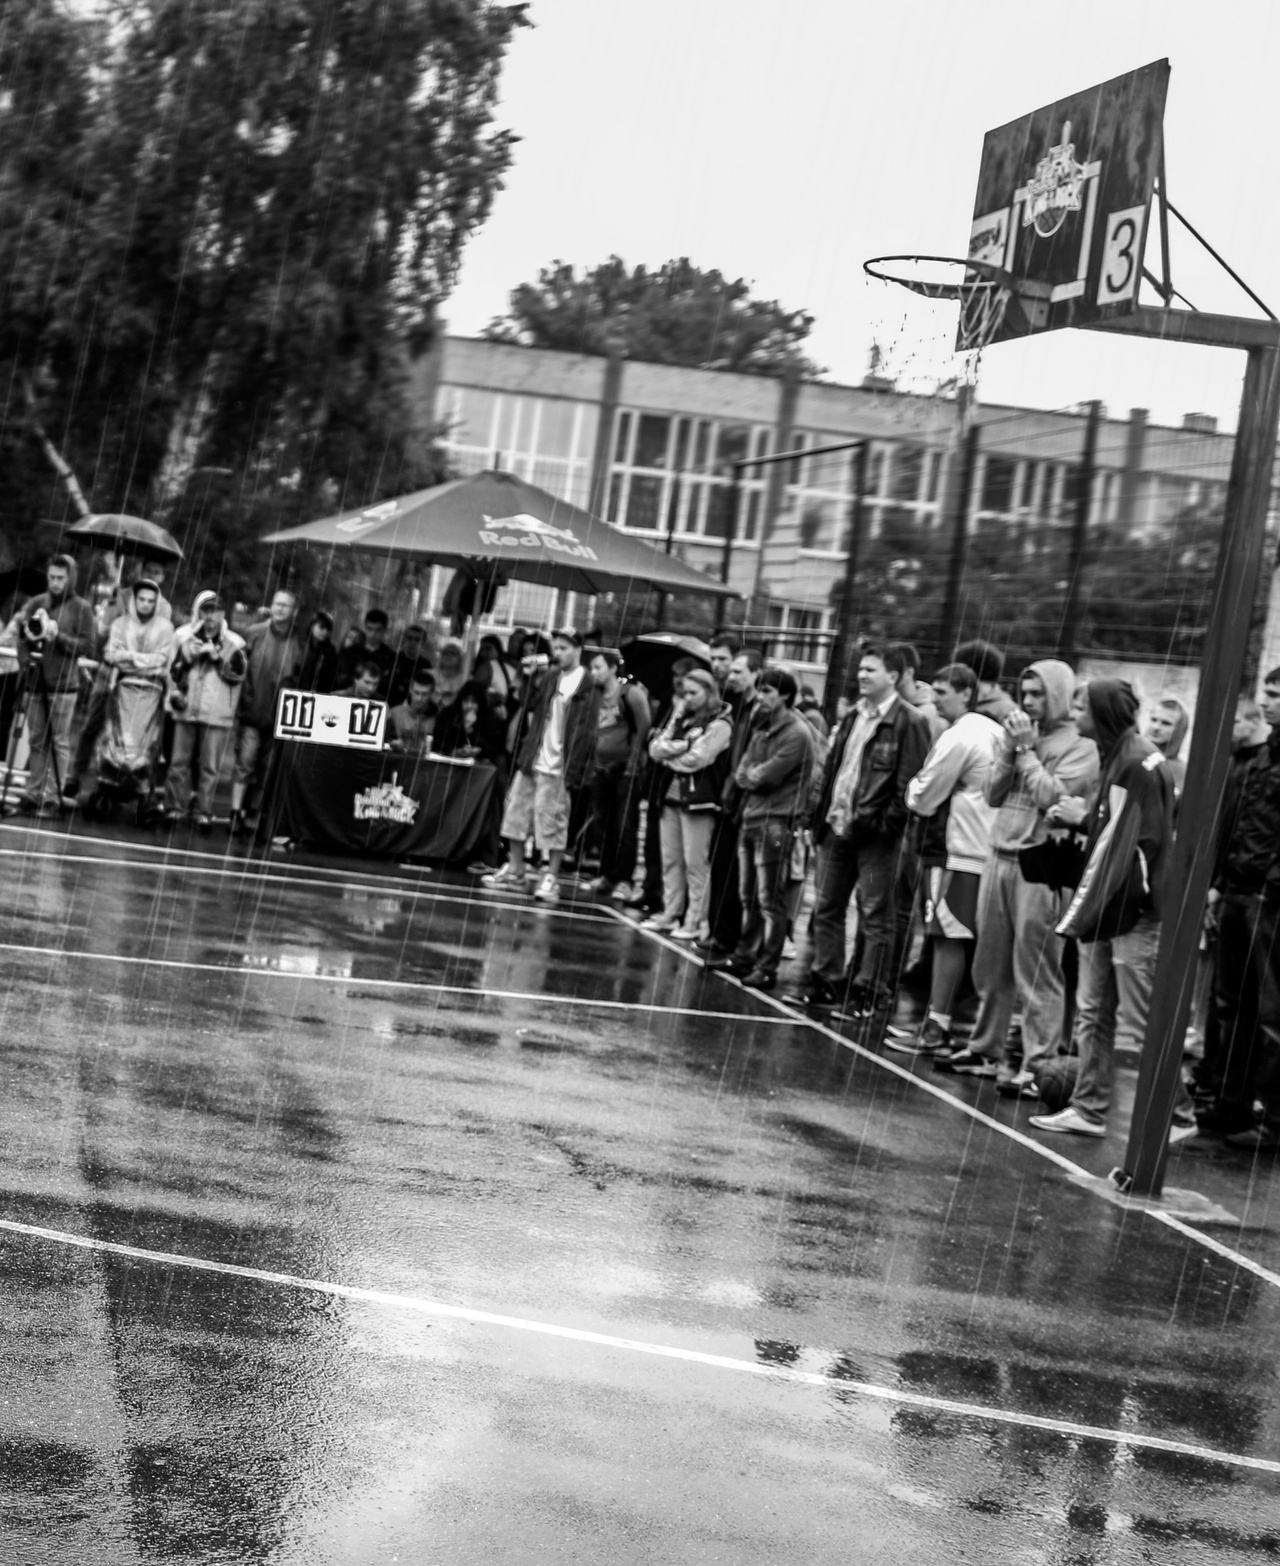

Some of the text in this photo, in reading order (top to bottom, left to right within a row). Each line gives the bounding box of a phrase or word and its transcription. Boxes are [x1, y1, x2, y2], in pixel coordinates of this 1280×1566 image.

[1106, 217, 1136, 293] 3
[478, 530, 599, 561] Red Bull
